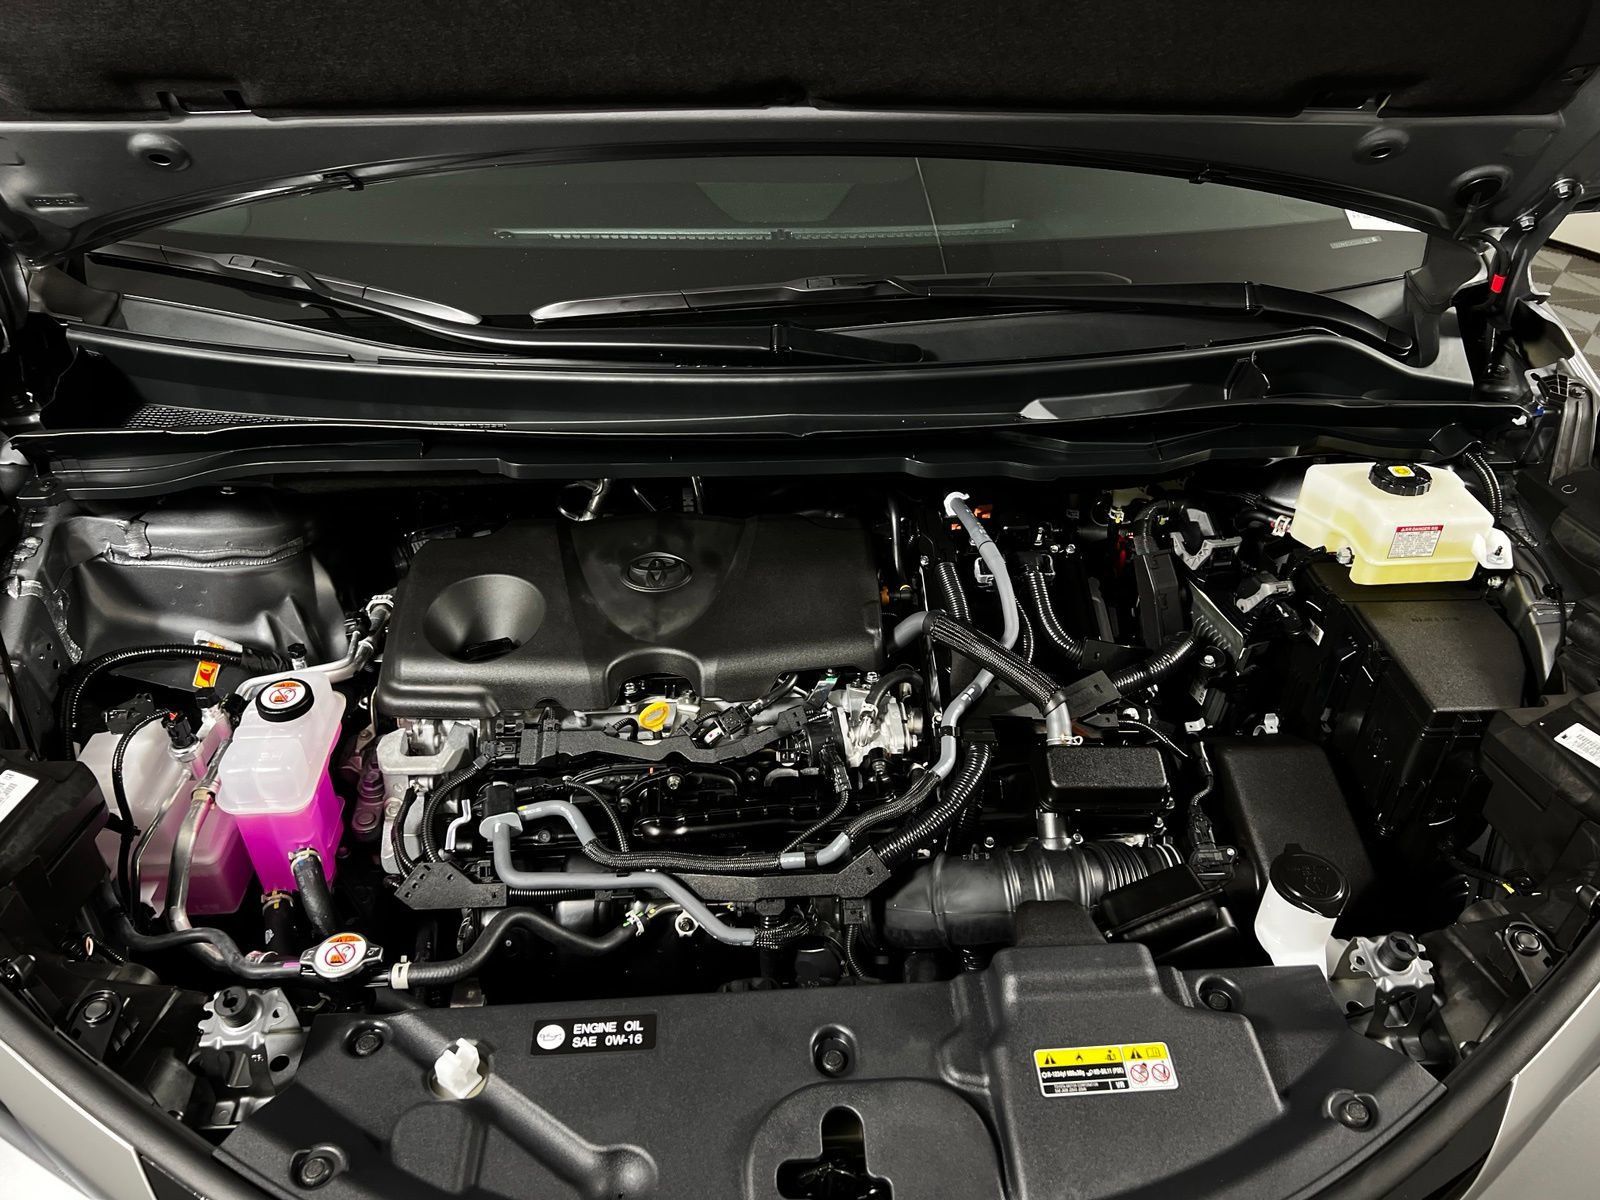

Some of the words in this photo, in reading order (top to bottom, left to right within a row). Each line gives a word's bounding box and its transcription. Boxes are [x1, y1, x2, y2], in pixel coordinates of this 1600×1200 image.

[573, 1021, 617, 1034] ENGINE
[624, 1020, 644, 1032] OIL
[572, 1036, 597, 1048] SAE
[605, 1034, 643, 1046] 0W-16
